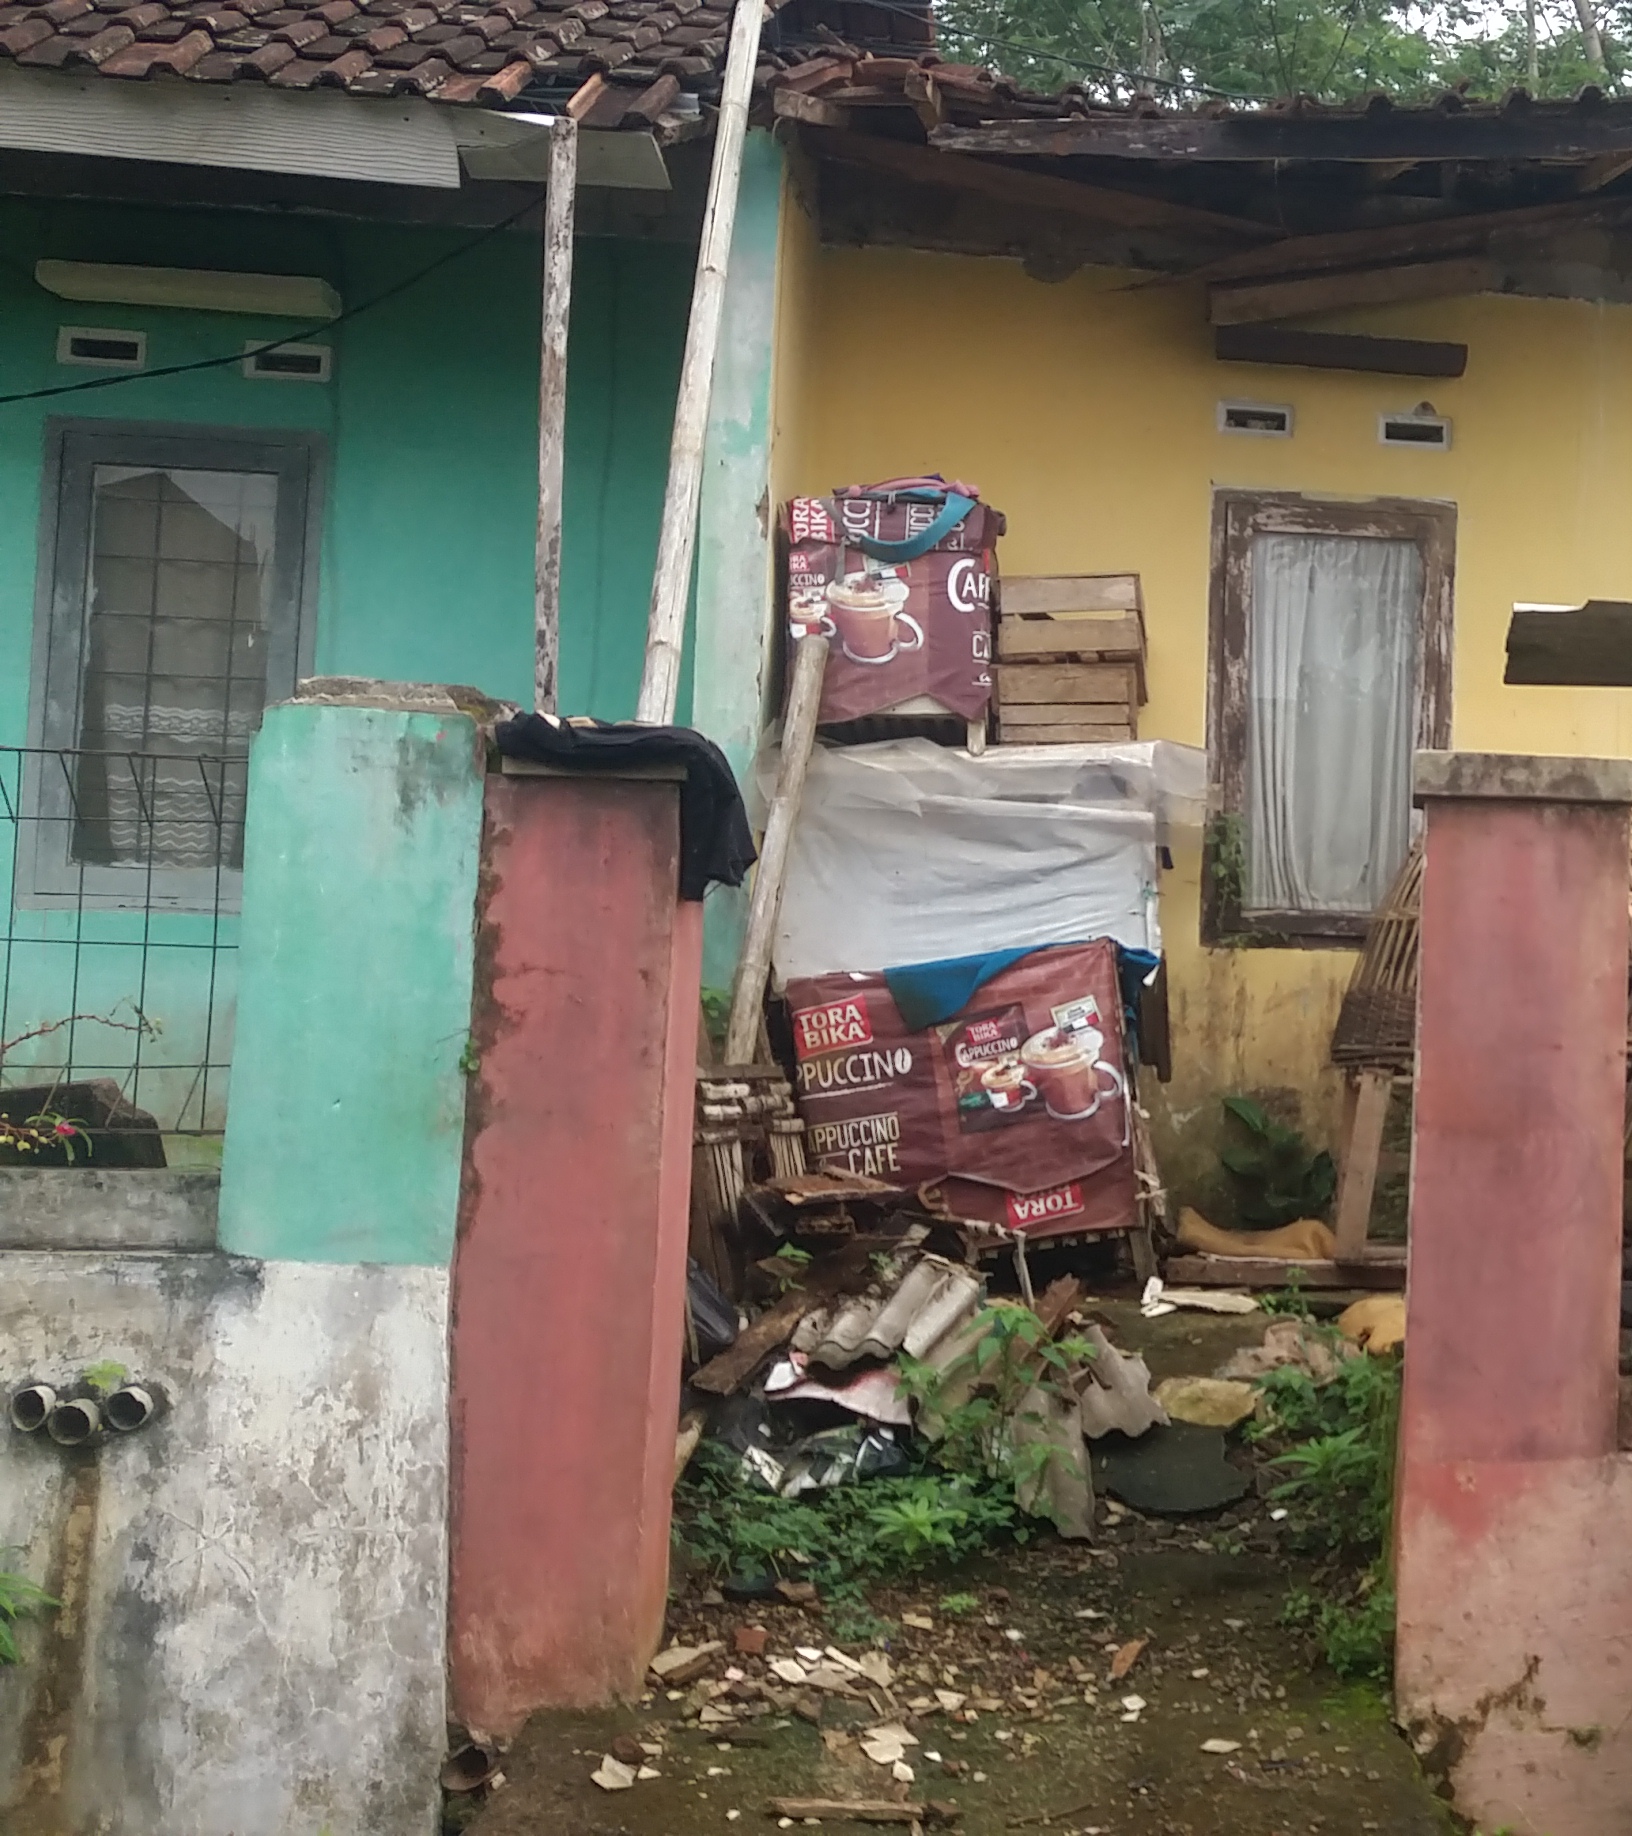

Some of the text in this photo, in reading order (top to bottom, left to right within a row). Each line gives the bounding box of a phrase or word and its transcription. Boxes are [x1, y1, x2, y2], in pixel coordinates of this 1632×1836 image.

[800, 1004, 863, 1033] TORA
[803, 1021, 866, 1049] BIKA
[955, 1037, 1018, 1068] CAPPUCCINO
[848, 1143, 901, 1177] CAFE
[1013, 1190, 1079, 1220] TORA
